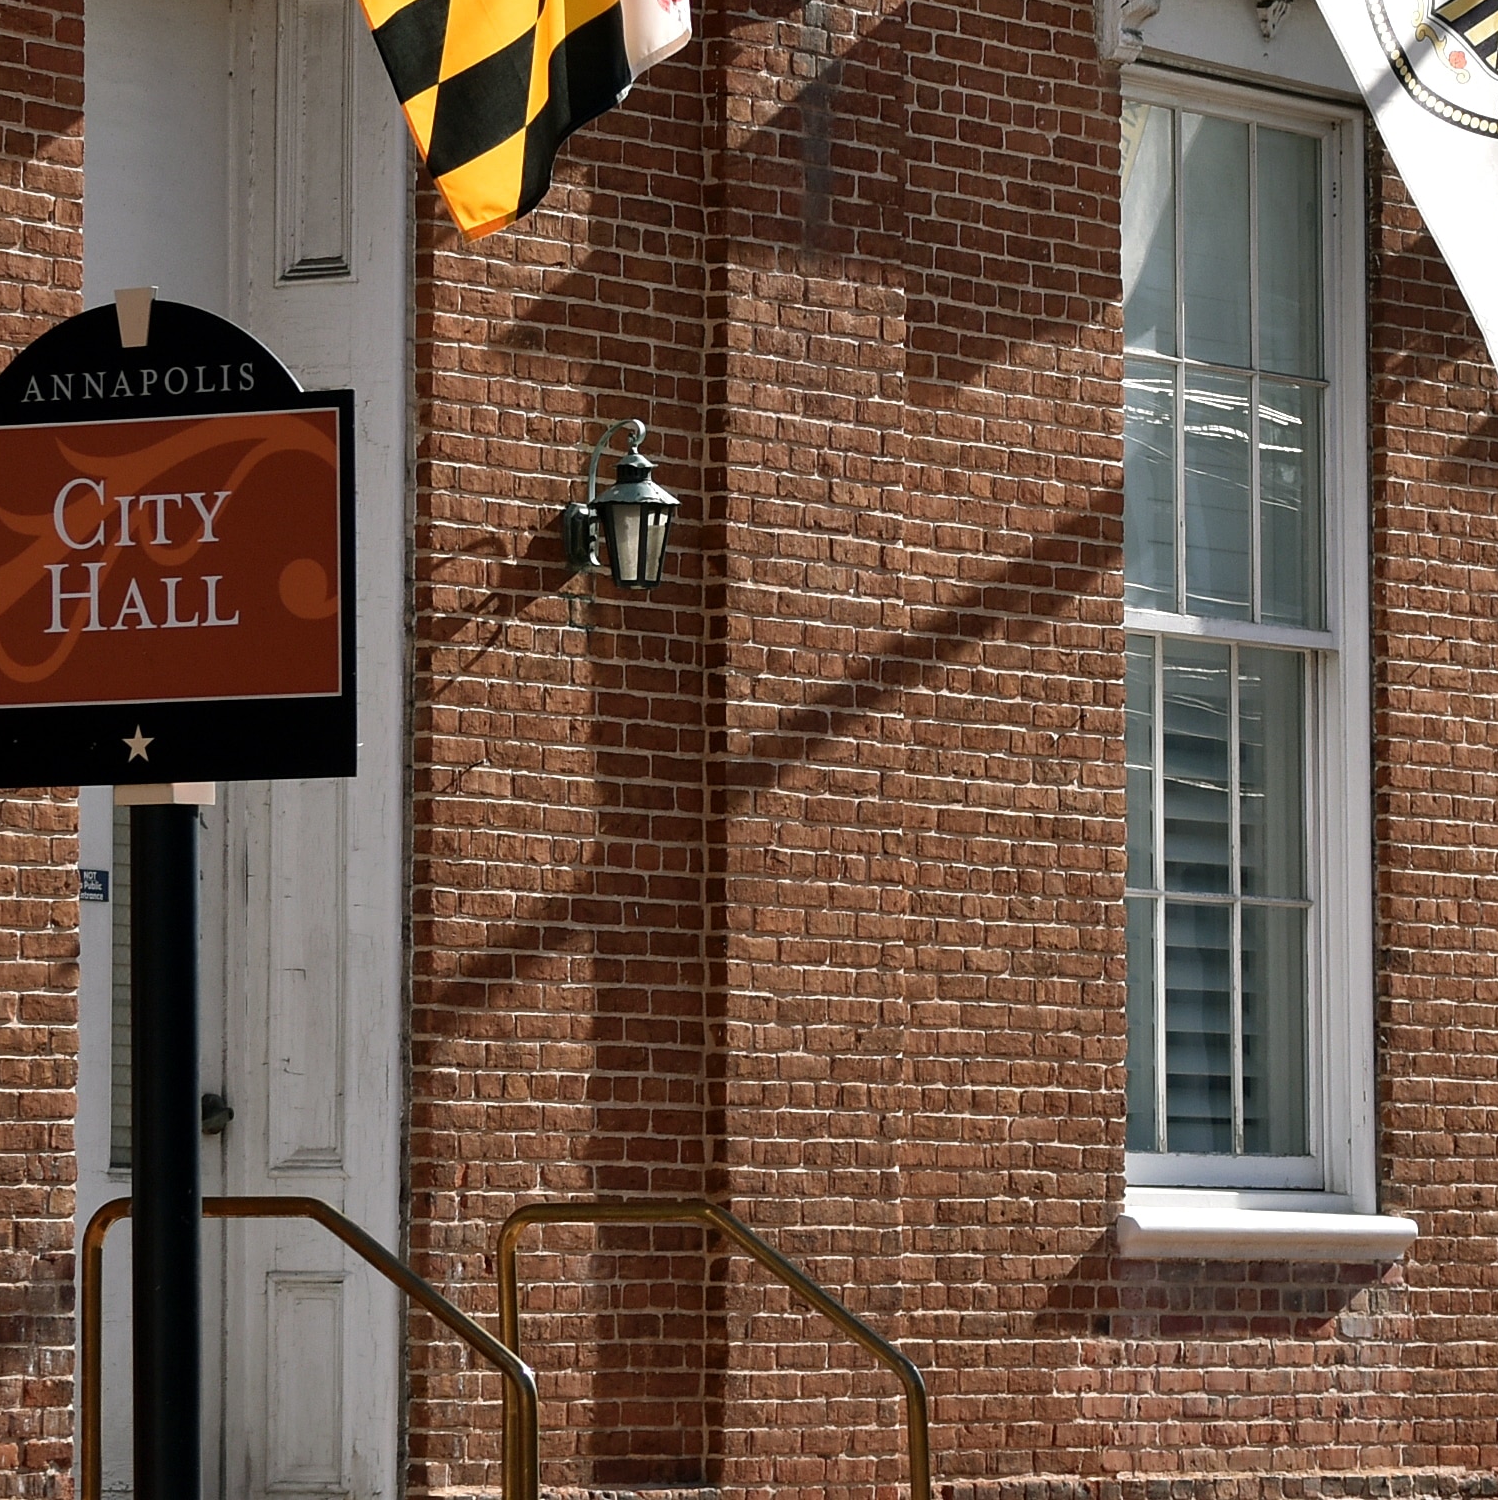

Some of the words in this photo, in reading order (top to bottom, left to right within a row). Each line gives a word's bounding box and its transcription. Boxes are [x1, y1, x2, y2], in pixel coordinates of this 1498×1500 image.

[20, 361, 256, 403] ANNAPOLIS
[52, 476, 232, 550] CITY
[43, 561, 240, 635] HALL
[84, 871, 97, 880] NOT
[84, 880, 103, 890] Public
[80, 892, 103, 900] ntrance
